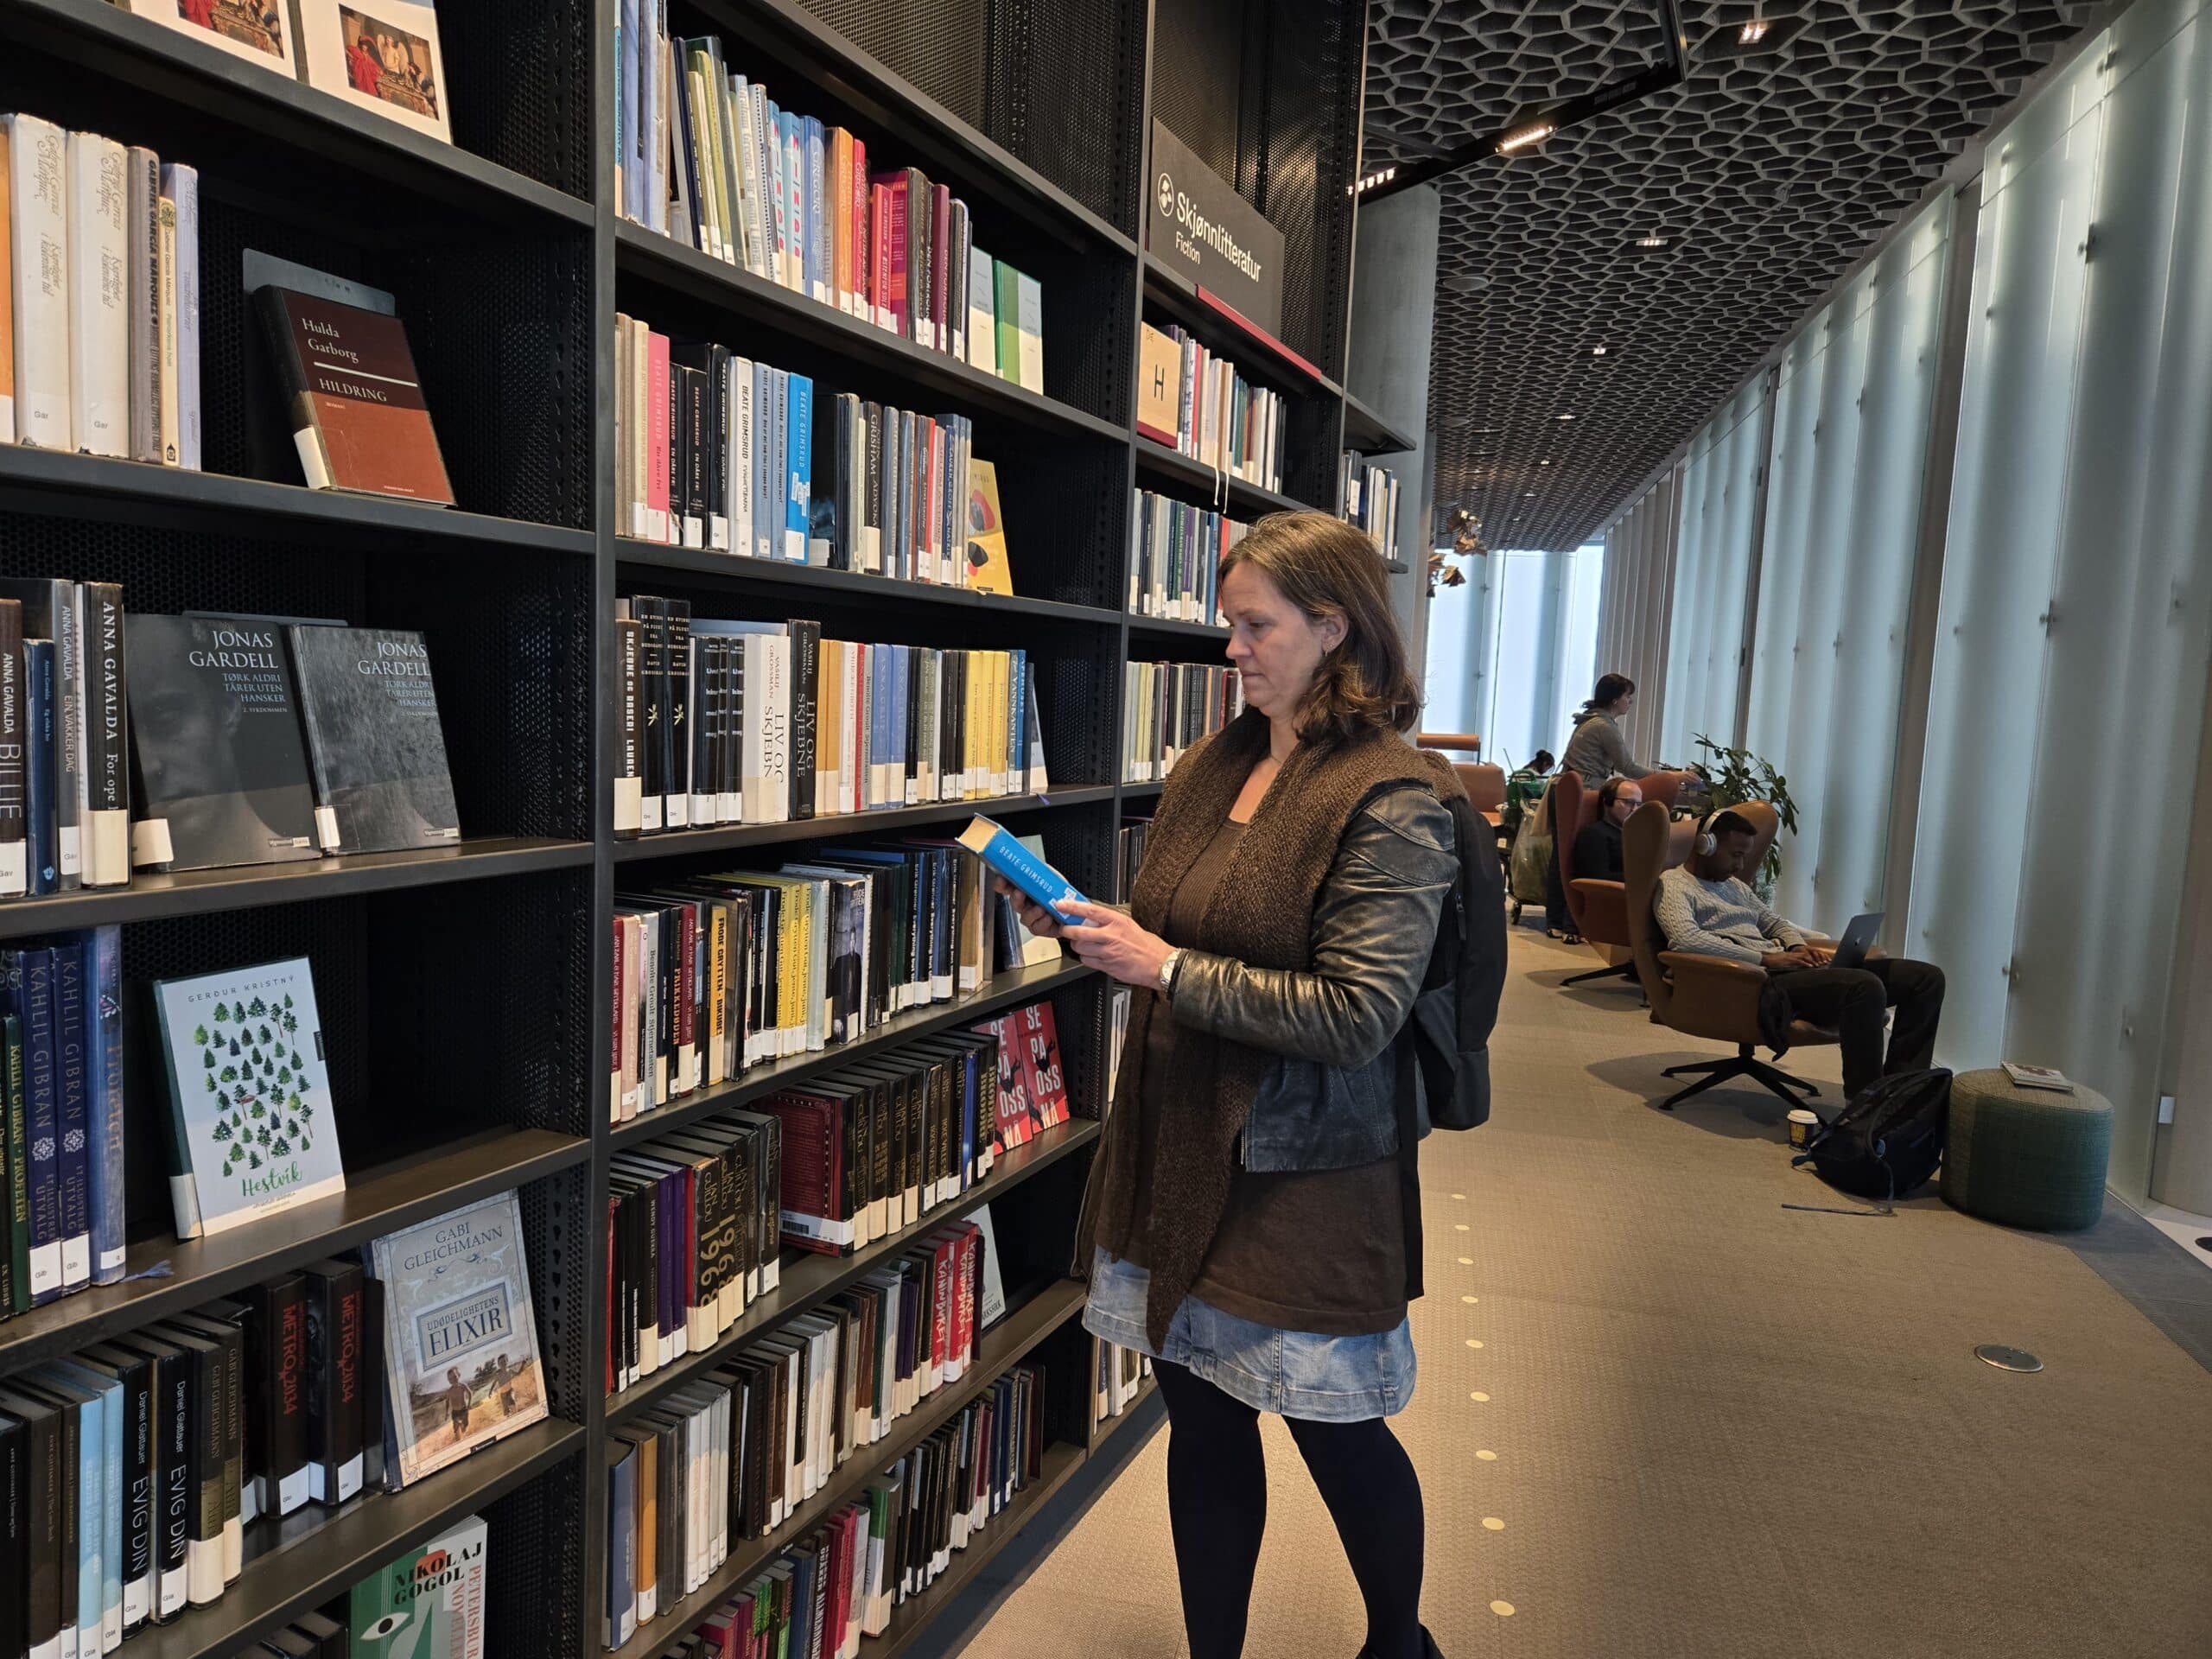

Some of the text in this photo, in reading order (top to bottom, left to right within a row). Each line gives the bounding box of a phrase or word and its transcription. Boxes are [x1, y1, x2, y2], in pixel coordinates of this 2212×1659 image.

[1175, 231, 1201, 264] Fiction
[1176, 191, 1262, 283] Skjønnlitteratur
[302, 318, 340, 338] Hulda
[308, 338, 359, 364] Garborg
[319, 378, 387, 402] HILDRING
[671, 448, 676, 457] EN
[695, 453, 700, 462] EN
[103, 601, 116, 656] ANNA
[213, 630, 274, 651] JONAS
[188, 651, 278, 669] GARDELL
[376, 642, 427, 659] JONAS
[3, 653, 14, 683] ANNA
[222, 672, 282, 683] TØRK ALDRI
[357, 659, 431, 677] GARDELL
[61, 606, 74, 772] ANNA GAVALDA EIN VAKKER DAG
[104, 658, 118, 741] GAVALDA
[222, 682, 283, 693] TÅRER UTEN
[240, 692, 286, 702] HANSKER
[3, 686, 14, 734] GAVALDA
[774, 715, 784, 745] LIV
[795, 693, 805, 778] SKJEBNE
[806, 701, 815, 770] LIV OG
[106, 753, 118, 775] For
[999, 845, 1053, 893] BEATE GRIMSRUD
[1027, 1005, 1041, 1030] SE
[29, 966, 51, 1128] KAHLIL GIBRAN
[62, 961, 81, 1120] KAHLIL GIBRAN
[1036, 1065, 1061, 1096] OSS
[1000, 1085, 1026, 1118] OSS
[1040, 1097, 1059, 1128] NÅ
[1004, 1120, 1023, 1149] NÅ
[35, 1185, 48, 1241] UTVALG
[65, 1177, 78, 1230] UTVALG
[403, 1225, 505, 1274] GLEICHMANN
[433, 1225, 472, 1244] GABI
[426, 1294, 499, 1332] UDØDELIGHETENS
[429, 1307, 505, 1358] ELIXIR
[283, 1306, 297, 1415] METRO 2034
[131, 1390, 149, 1573] Daniel Glattauer EVIG DIN
[169, 1381, 187, 1560] Daniel Glattauer EVIG DIN
[394, 1541, 484, 1588] NIKOLAJ
[393, 1566, 466, 1607] GOGOL
[467, 1565, 482, 1659] PETERSBUR
